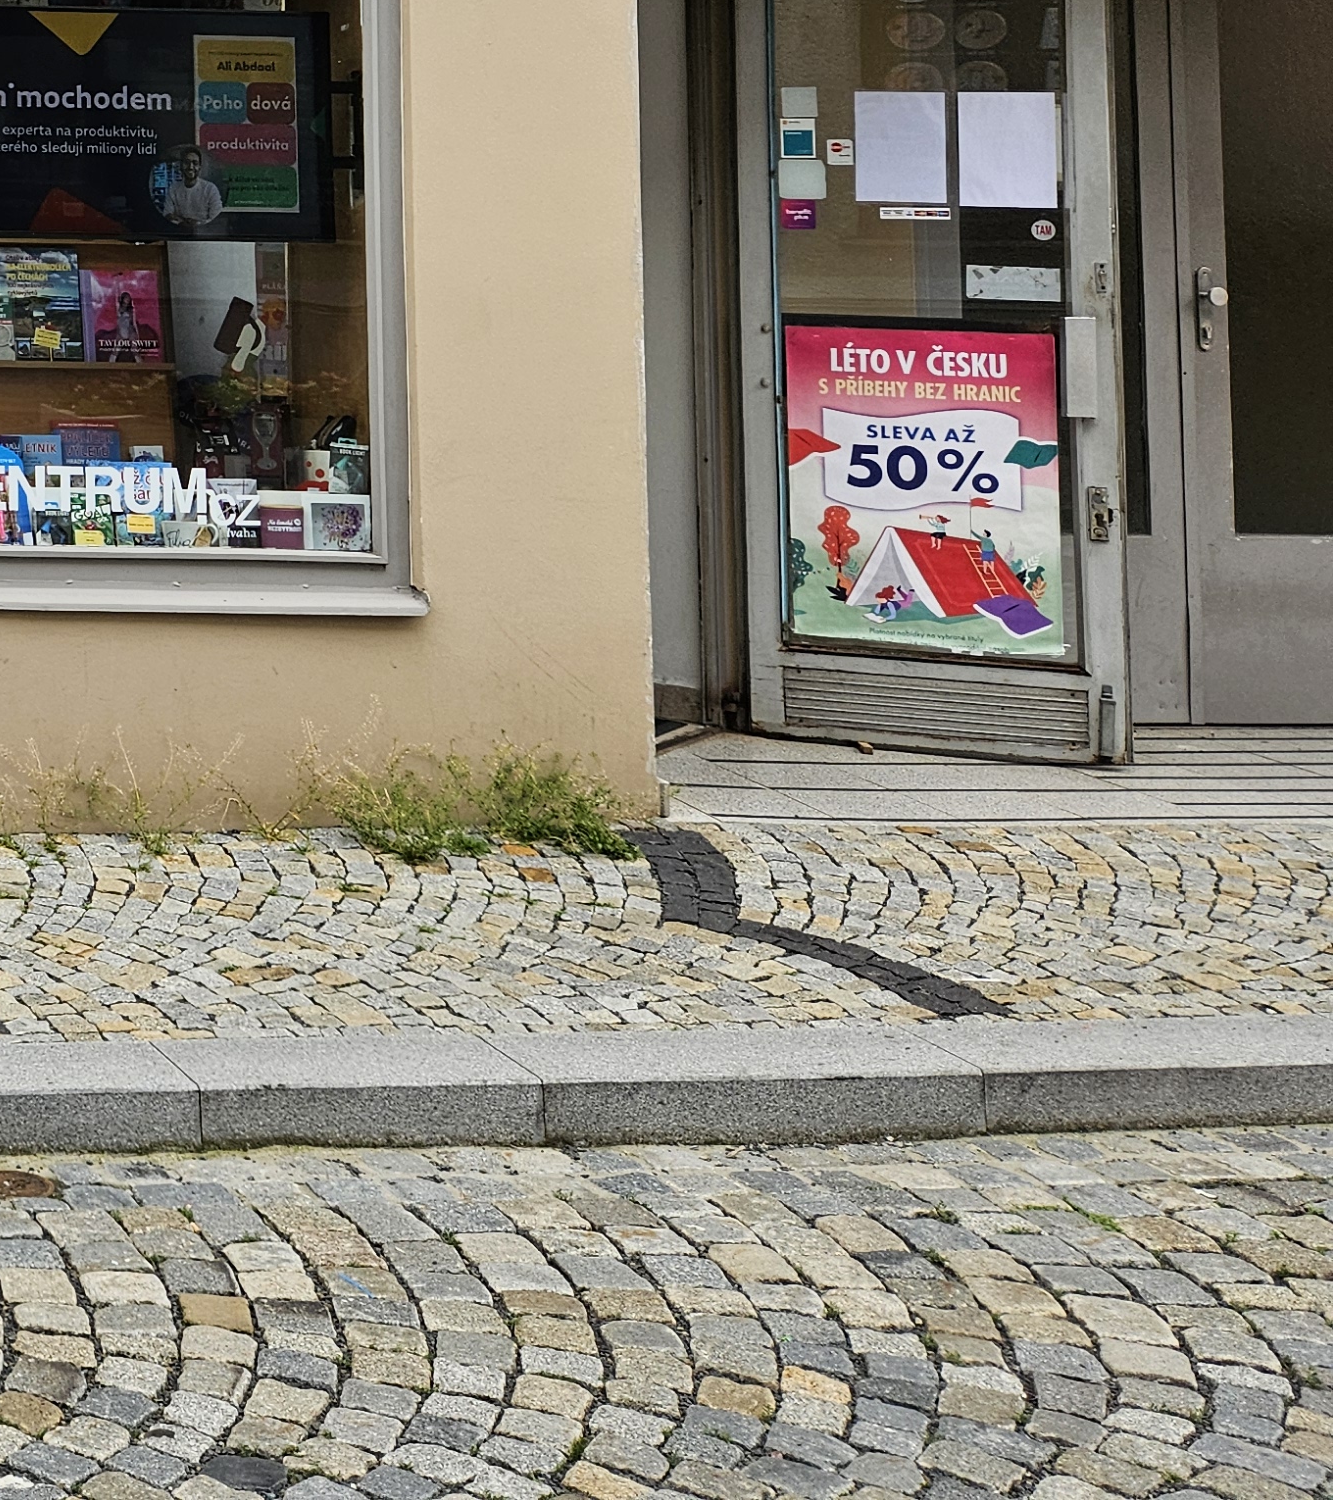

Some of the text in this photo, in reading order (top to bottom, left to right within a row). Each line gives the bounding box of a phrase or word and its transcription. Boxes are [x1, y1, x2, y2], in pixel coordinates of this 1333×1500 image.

[217, 61, 276, 73] Ali Abdaal
[2, 125, 53, 138] experta
[56, 127, 72, 137] na
[75, 125, 159, 140] produktivitu,
[41, 141, 83, 157] sledují
[87, 142, 134, 157] miliony
[137, 142, 158, 155] lidí
[207, 138, 290, 152] produktivita
[1034, 224, 1053, 236] TAM
[98, 339, 159, 348] TAYLOR SWIFT
[829, 341, 1009, 380] LÉTO V ČESKU
[818, 377, 829, 395] S
[914, 381, 947, 401] BEZ
[953, 382, 1022, 404] HRANIC
[866, 424, 977, 443] SLEVA AŽ
